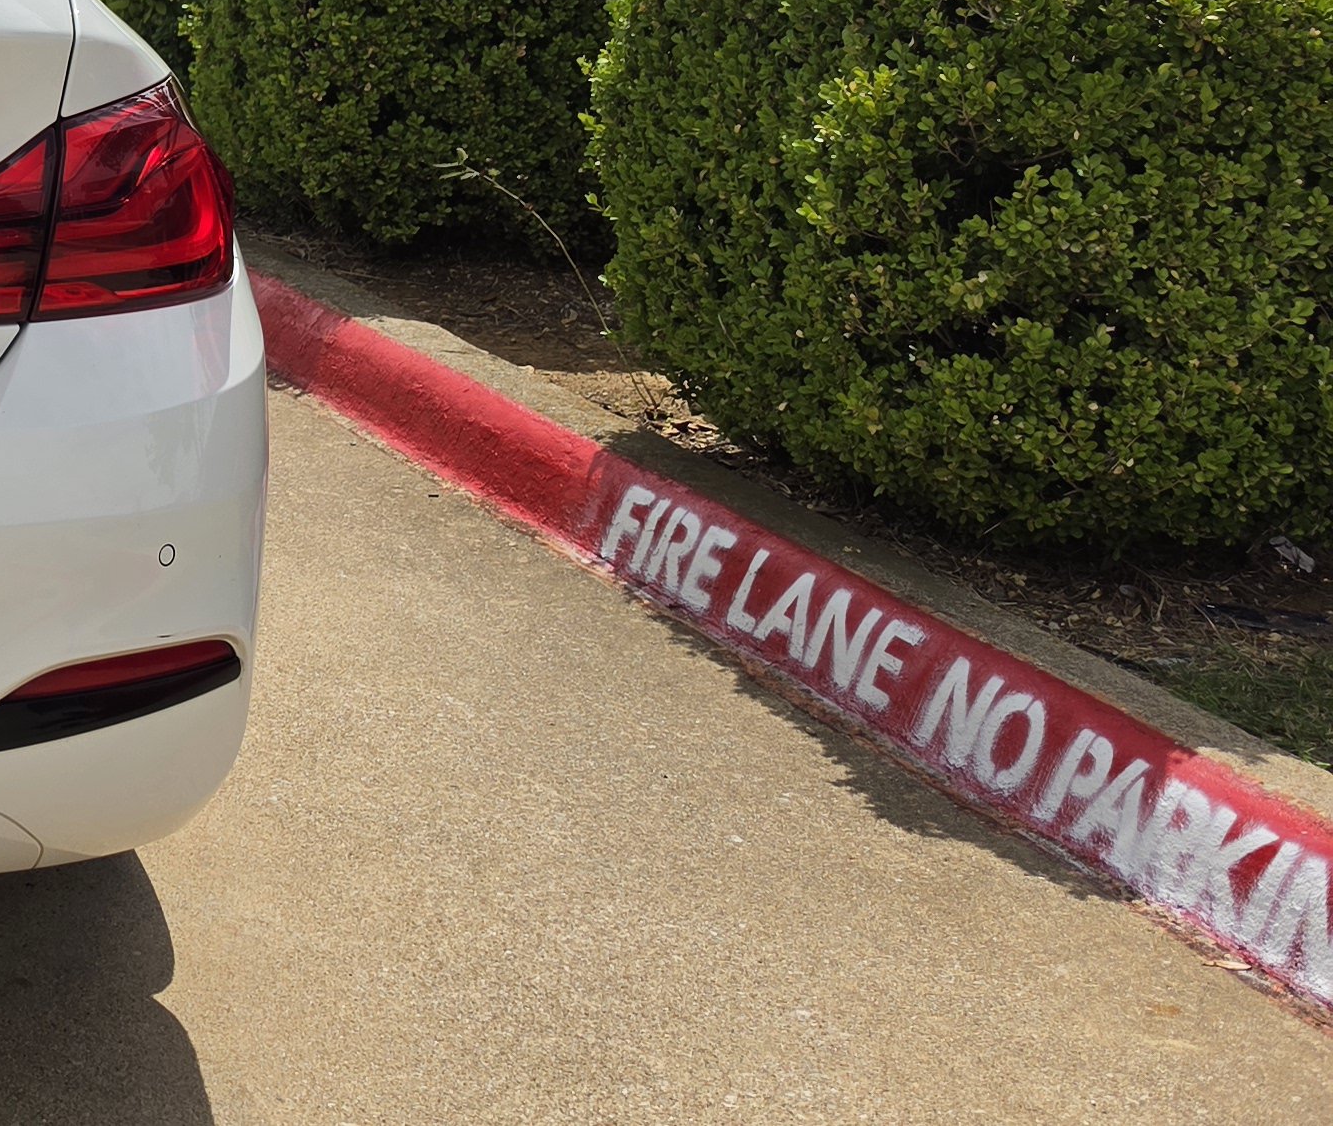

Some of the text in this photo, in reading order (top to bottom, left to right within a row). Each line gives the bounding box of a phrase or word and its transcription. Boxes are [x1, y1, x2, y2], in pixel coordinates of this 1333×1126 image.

[599, 484, 737, 616] FIRE
[726, 548, 929, 712] LANE
[914, 656, 1048, 793] NO
